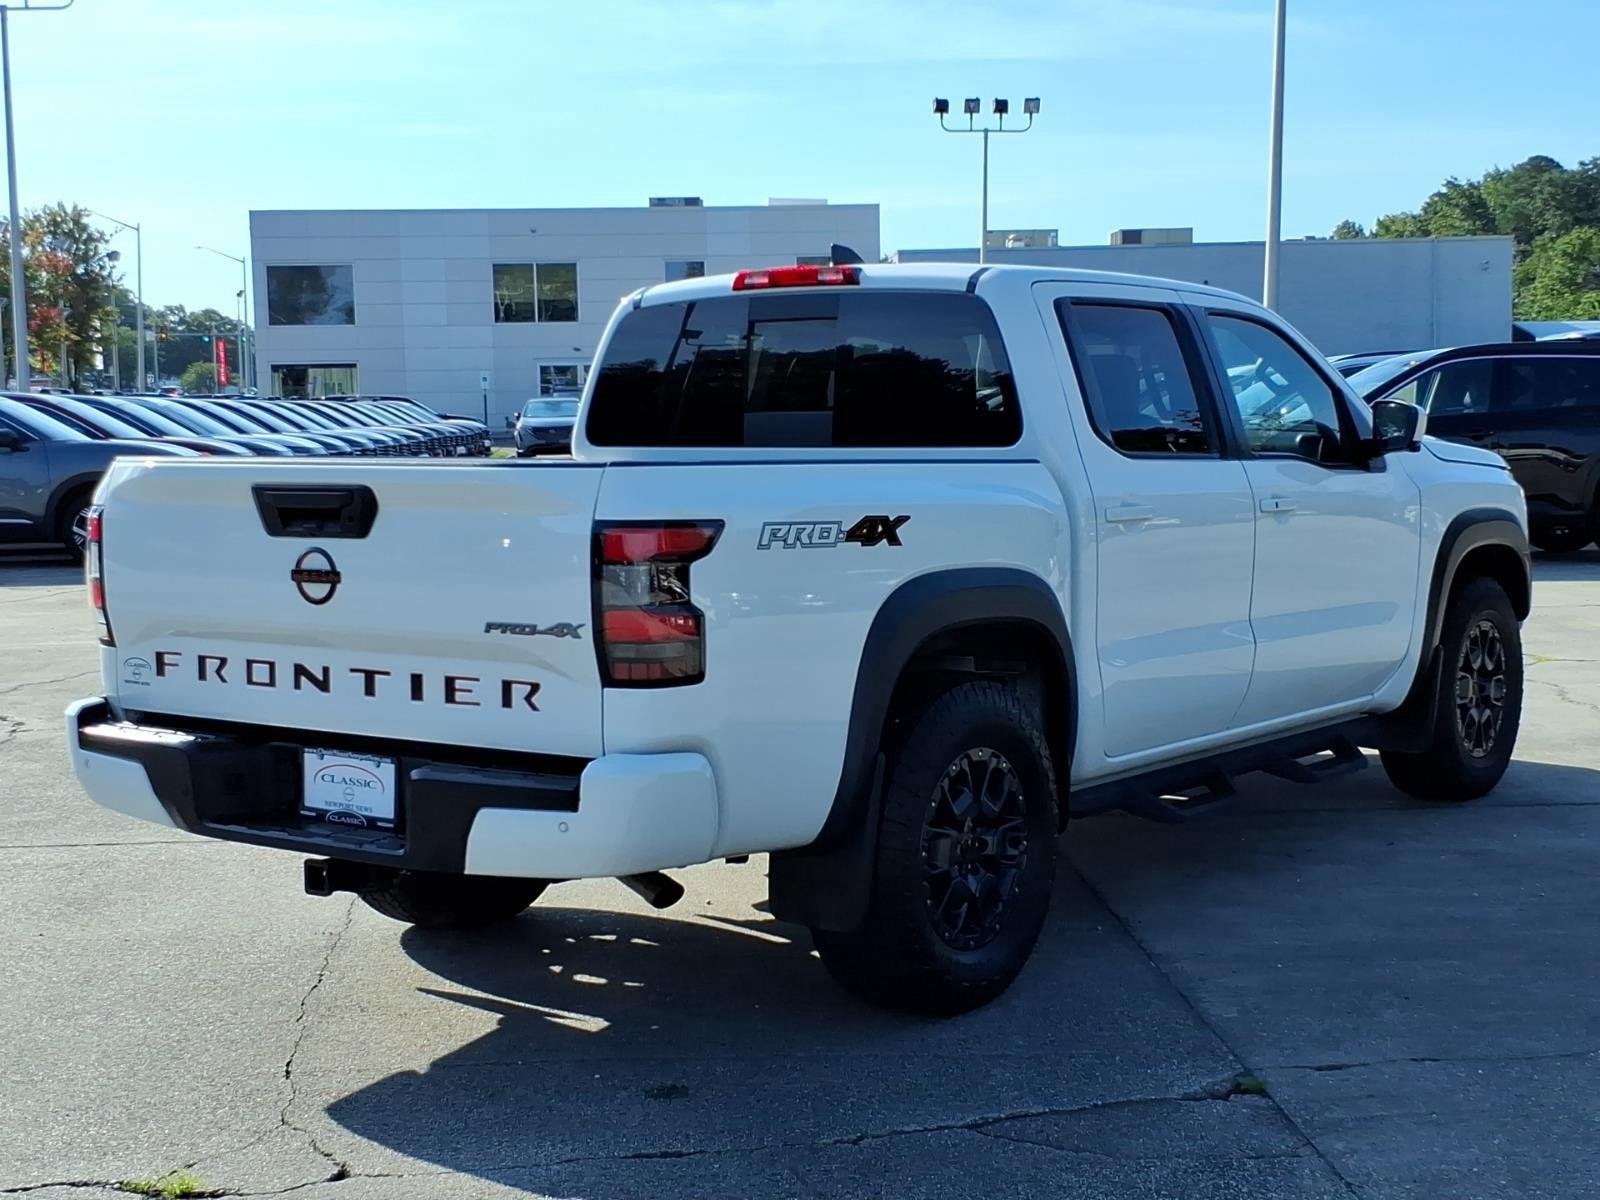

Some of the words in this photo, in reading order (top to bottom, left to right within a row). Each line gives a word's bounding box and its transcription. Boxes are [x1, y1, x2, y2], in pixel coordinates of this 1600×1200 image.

[155, 651, 541, 712] FRONTIER
[321, 773, 377, 789] CLASSIC
[324, 800, 354, 809] NEWPORT
[356, 805, 373, 813] NEWS
[329, 814, 362, 825] CLASSIC
